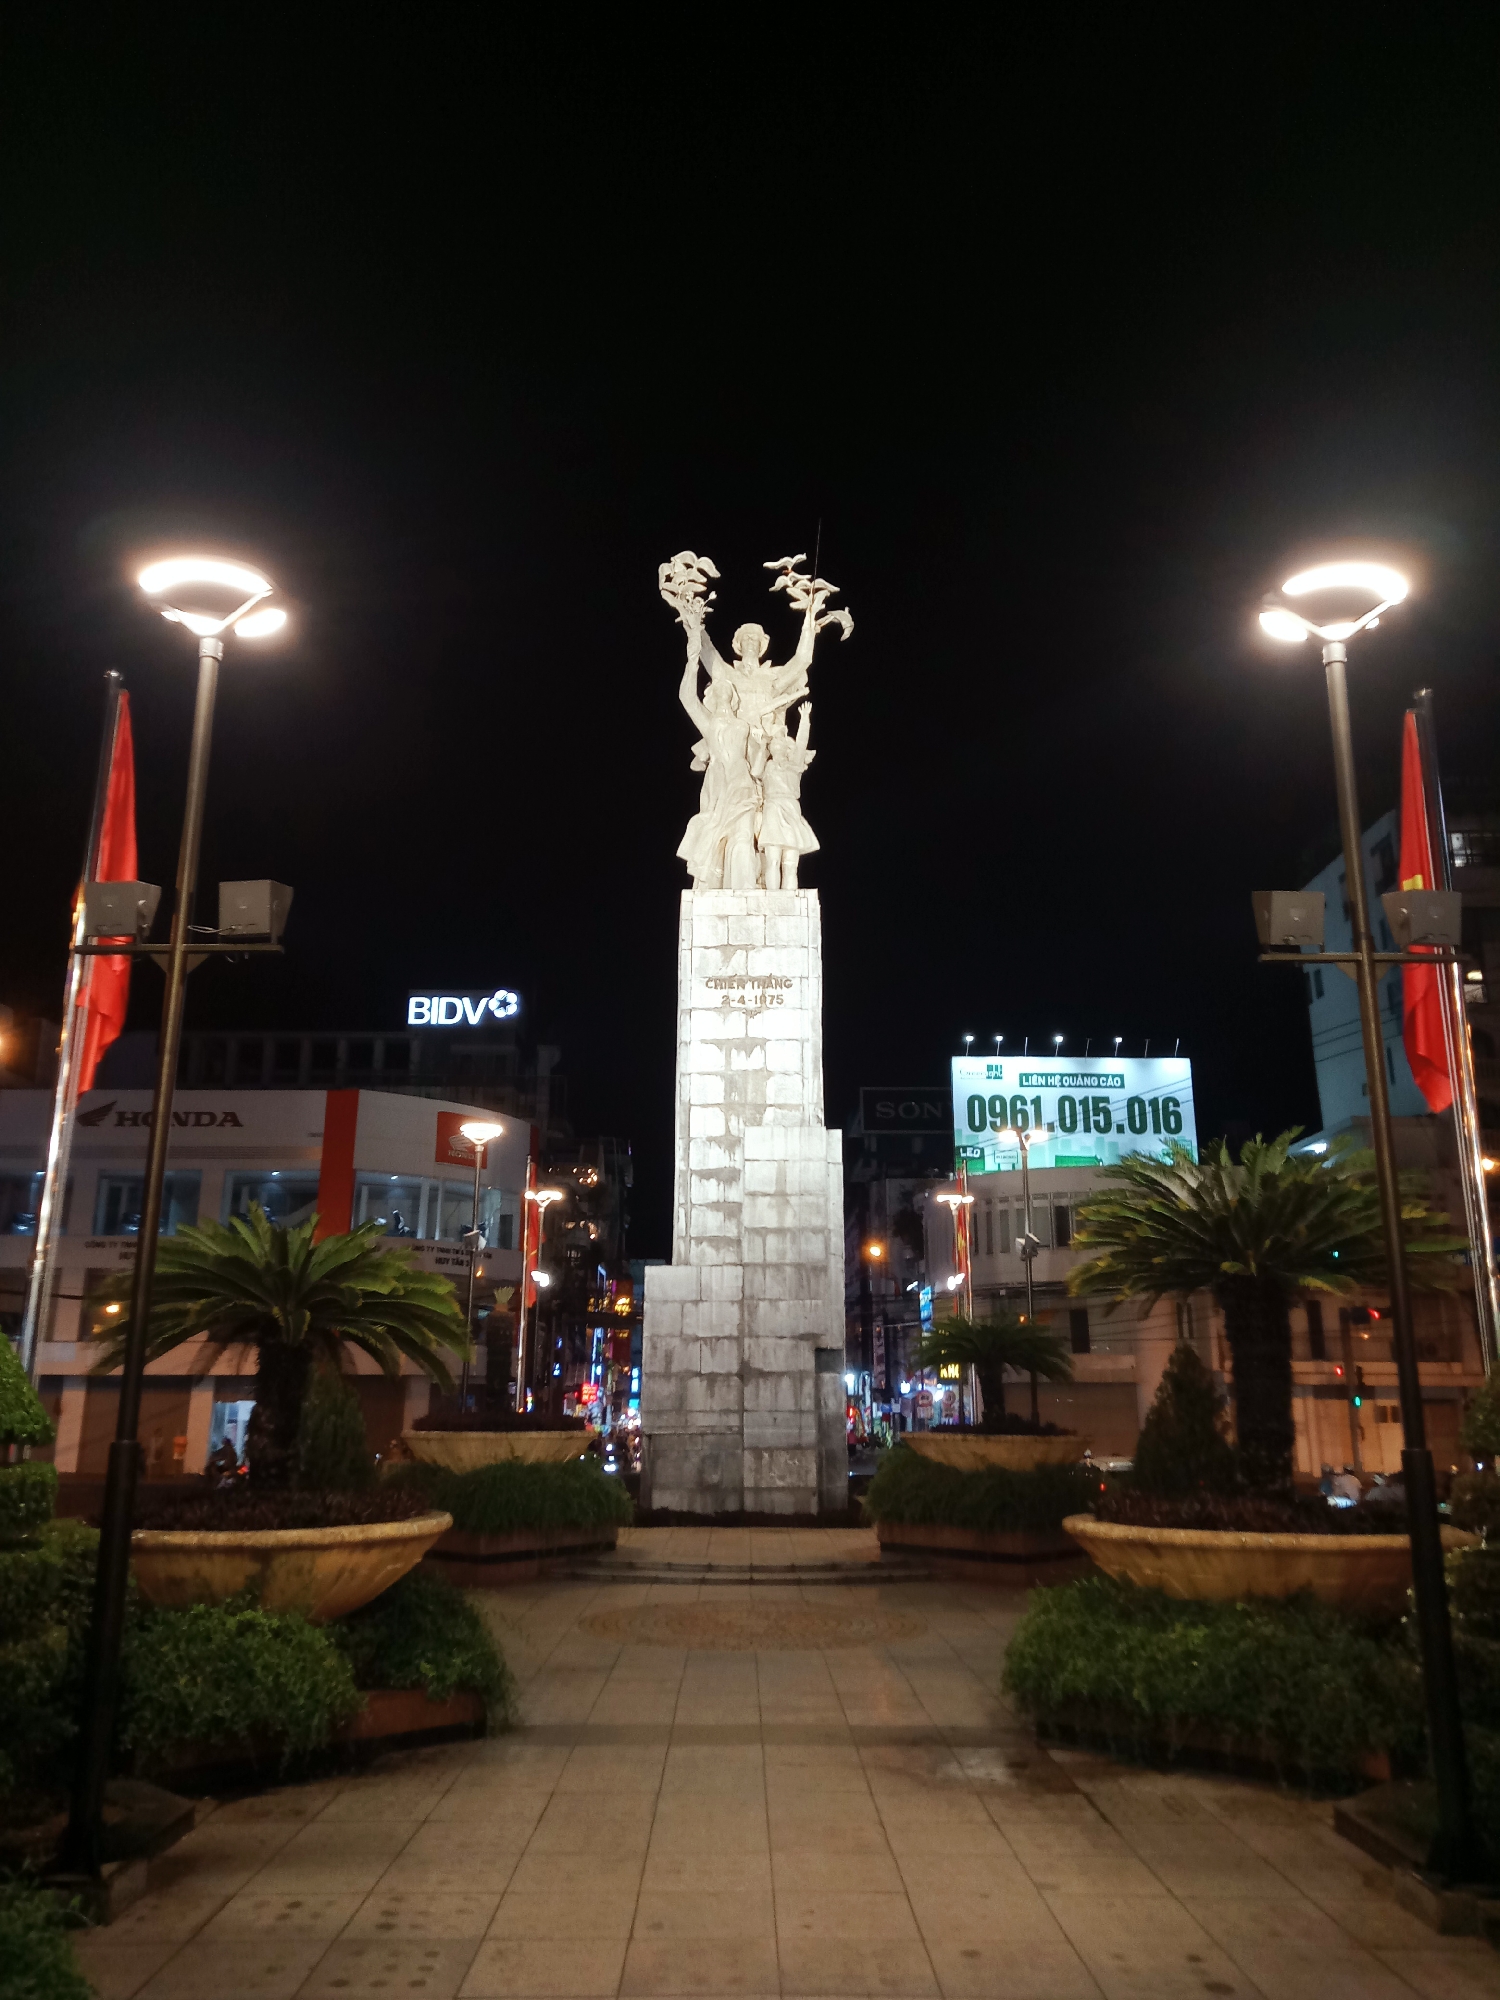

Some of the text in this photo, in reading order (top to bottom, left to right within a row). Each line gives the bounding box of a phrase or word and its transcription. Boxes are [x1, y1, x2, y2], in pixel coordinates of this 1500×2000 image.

[408, 996, 490, 1025] BIDV
[1022, 1074, 1121, 1088] LIÊN HỆ QUẢNG CÁO
[876, 1101, 952, 1119] SON
[967, 1095, 1183, 1134] 0961.015.016
